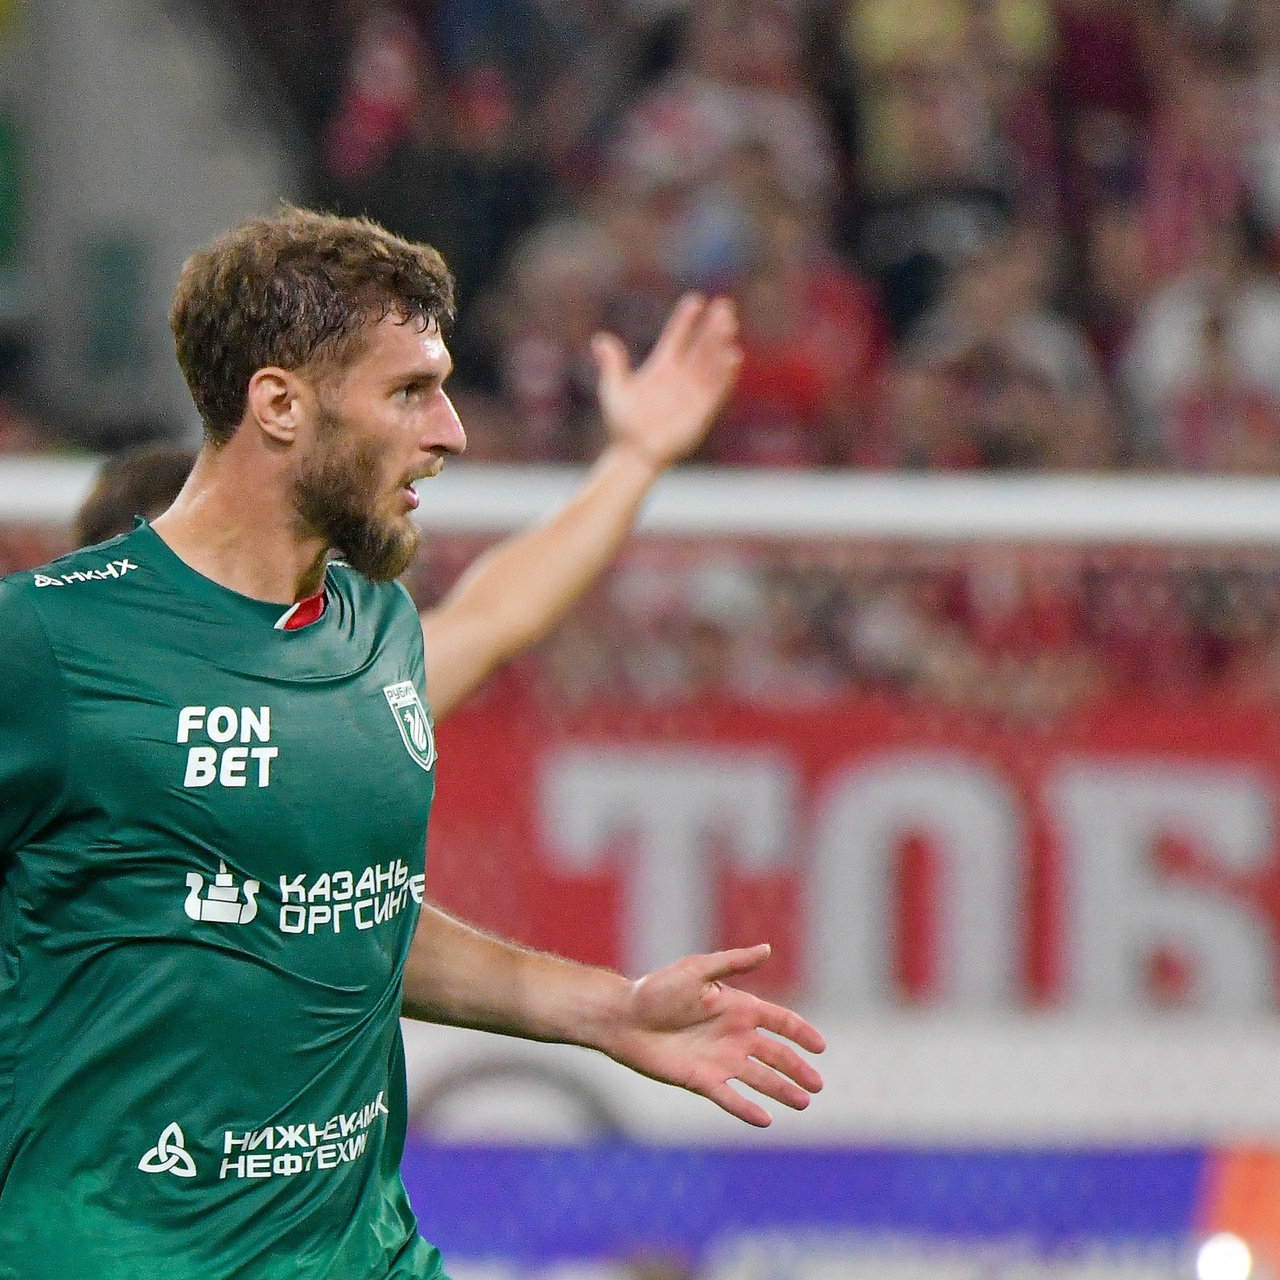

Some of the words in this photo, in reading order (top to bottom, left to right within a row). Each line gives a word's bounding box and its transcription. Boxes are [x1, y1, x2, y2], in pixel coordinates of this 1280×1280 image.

[176, 706, 271, 743] FON
[183, 746, 279, 788] BET
[279, 858, 409, 903] КАЗАНЬ
